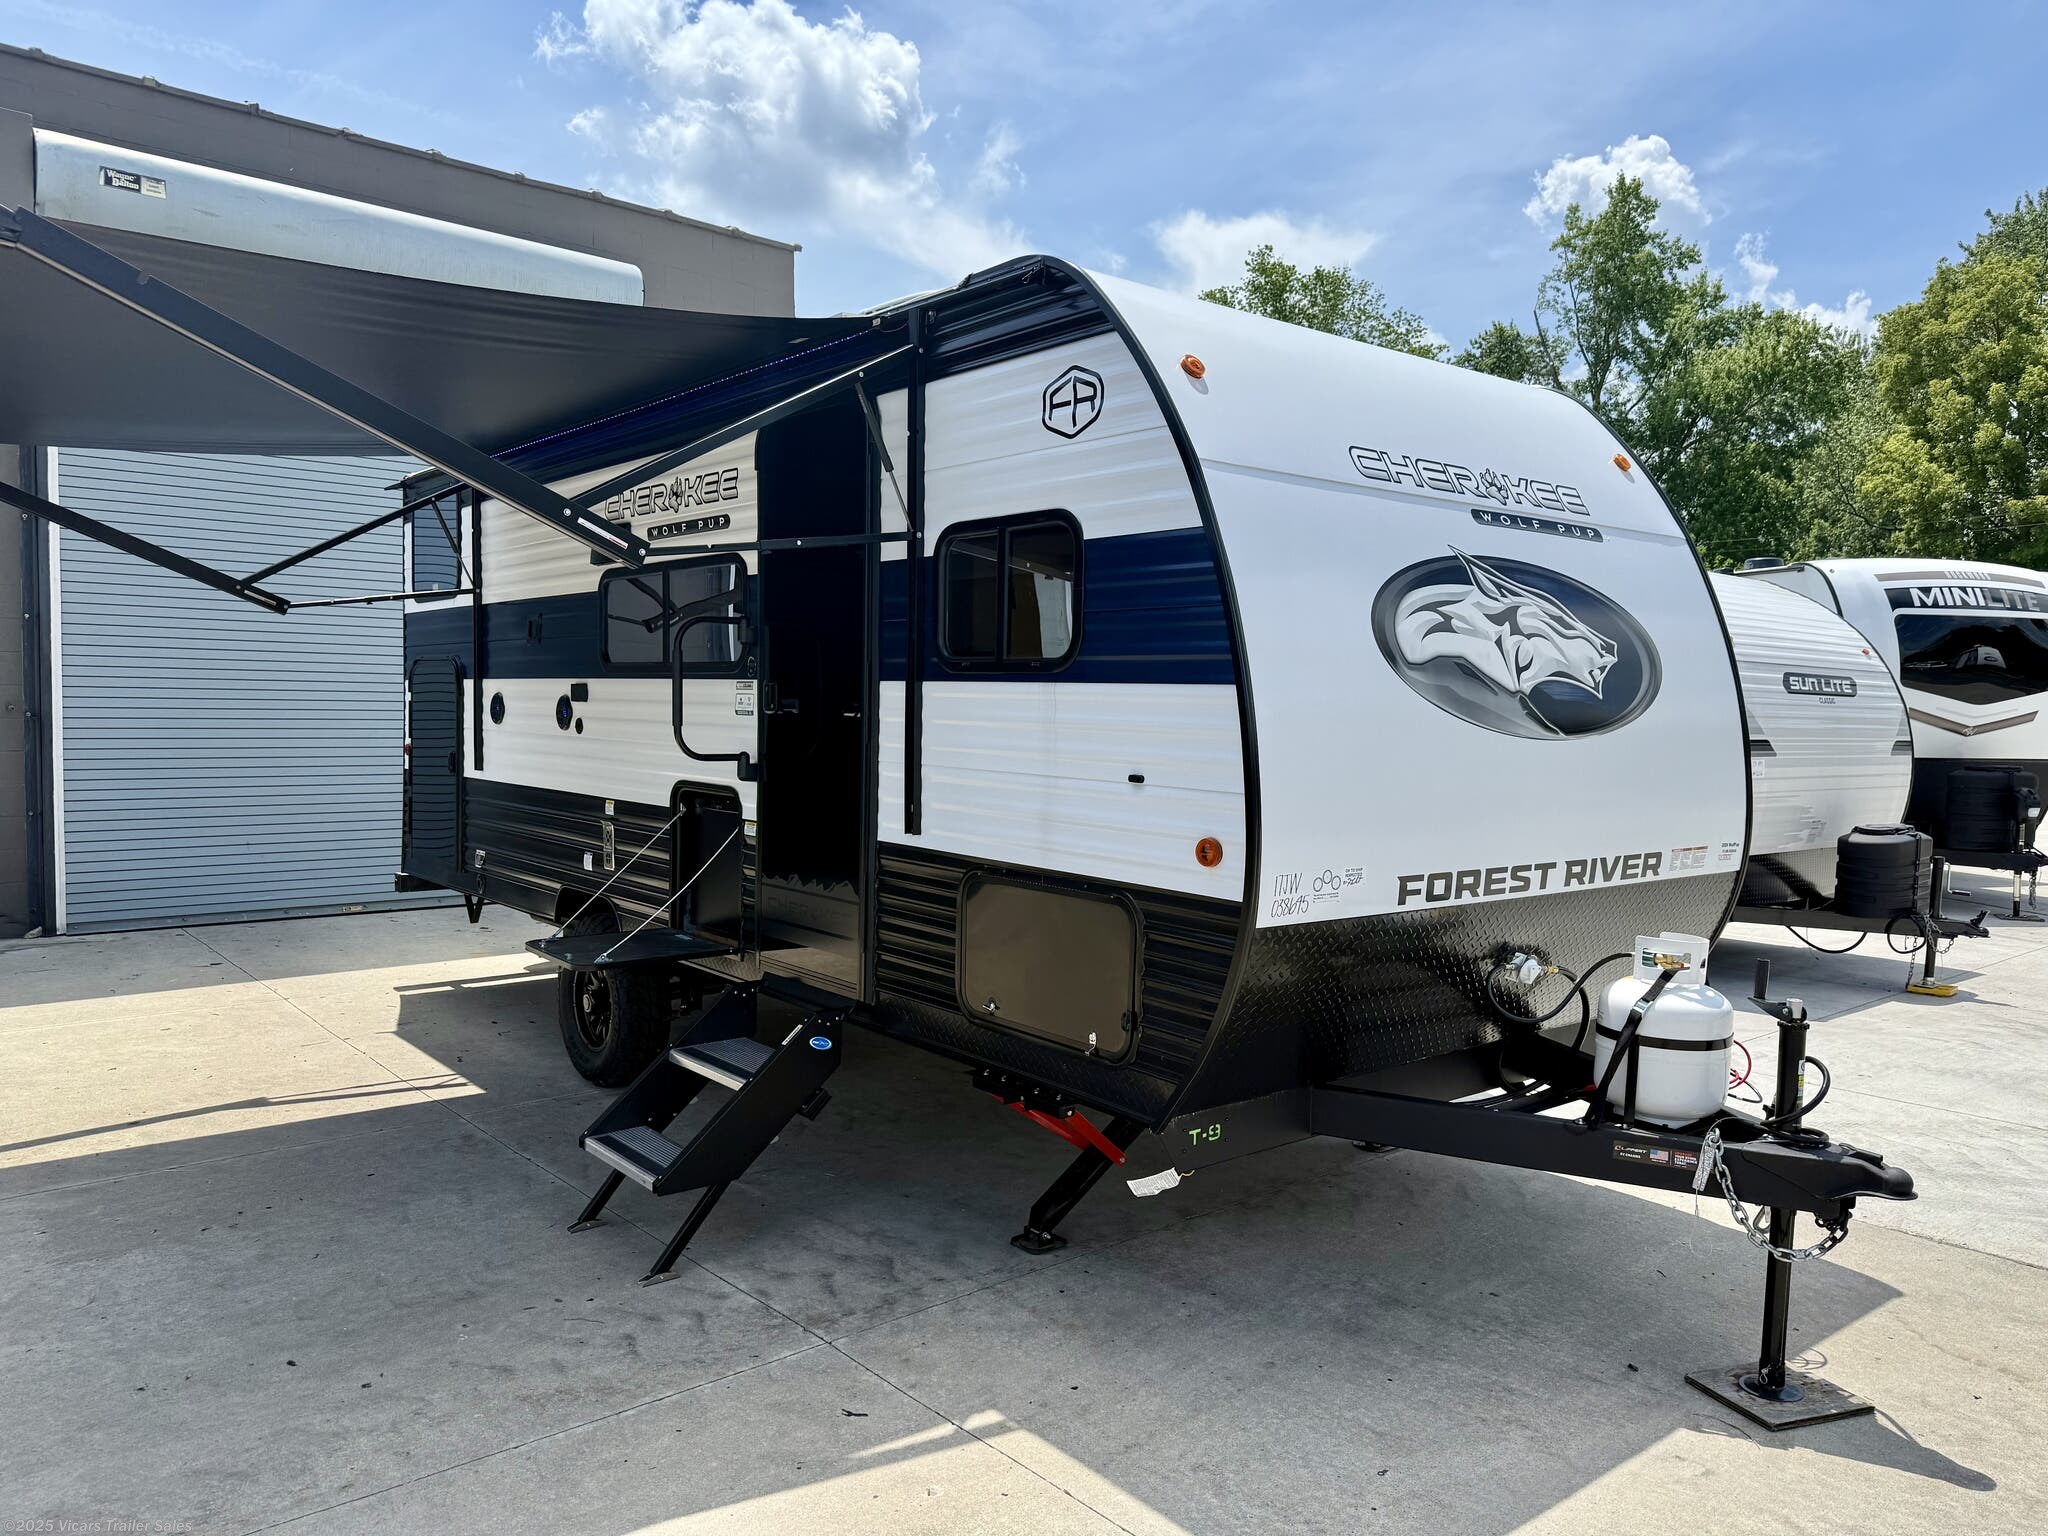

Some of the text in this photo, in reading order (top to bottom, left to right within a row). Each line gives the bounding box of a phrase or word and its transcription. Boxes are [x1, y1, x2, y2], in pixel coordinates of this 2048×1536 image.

[106, 169, 135, 181] Wayne
[112, 178, 139, 190] Dalton
[651, 517, 725, 537] WOLF PUP
[1479, 511, 1596, 539] WOLF PUP
[1397, 862, 1558, 906] FOREST
[1564, 851, 1663, 888] RIVER
